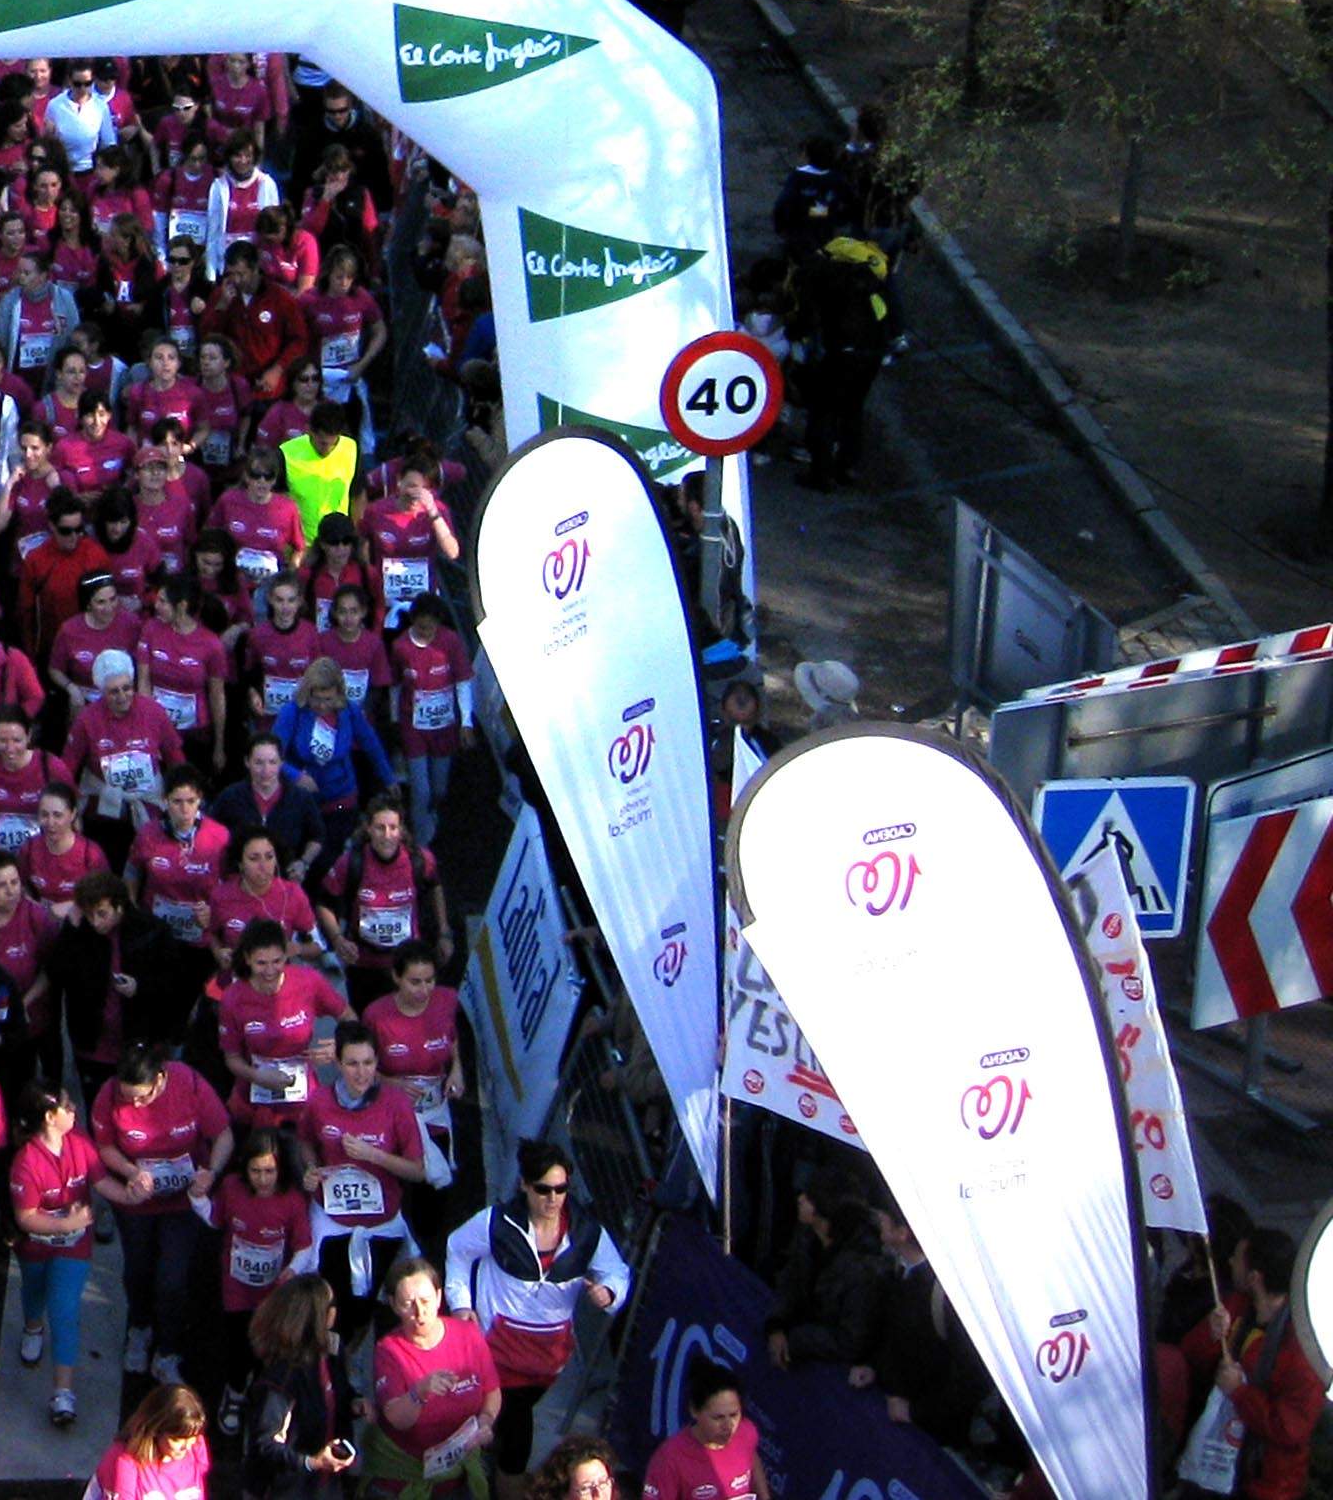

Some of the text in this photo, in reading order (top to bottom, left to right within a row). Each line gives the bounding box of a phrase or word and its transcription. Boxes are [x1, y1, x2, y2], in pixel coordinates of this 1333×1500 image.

[399, 31, 561, 71] El Corte Inglés
[526, 245, 677, 288] El Corte Inglés
[686, 375, 757, 416] 40
[269, 693, 292, 706] 154
[369, 921, 402, 936] 4598
[333, 1183, 371, 1200] 6575
